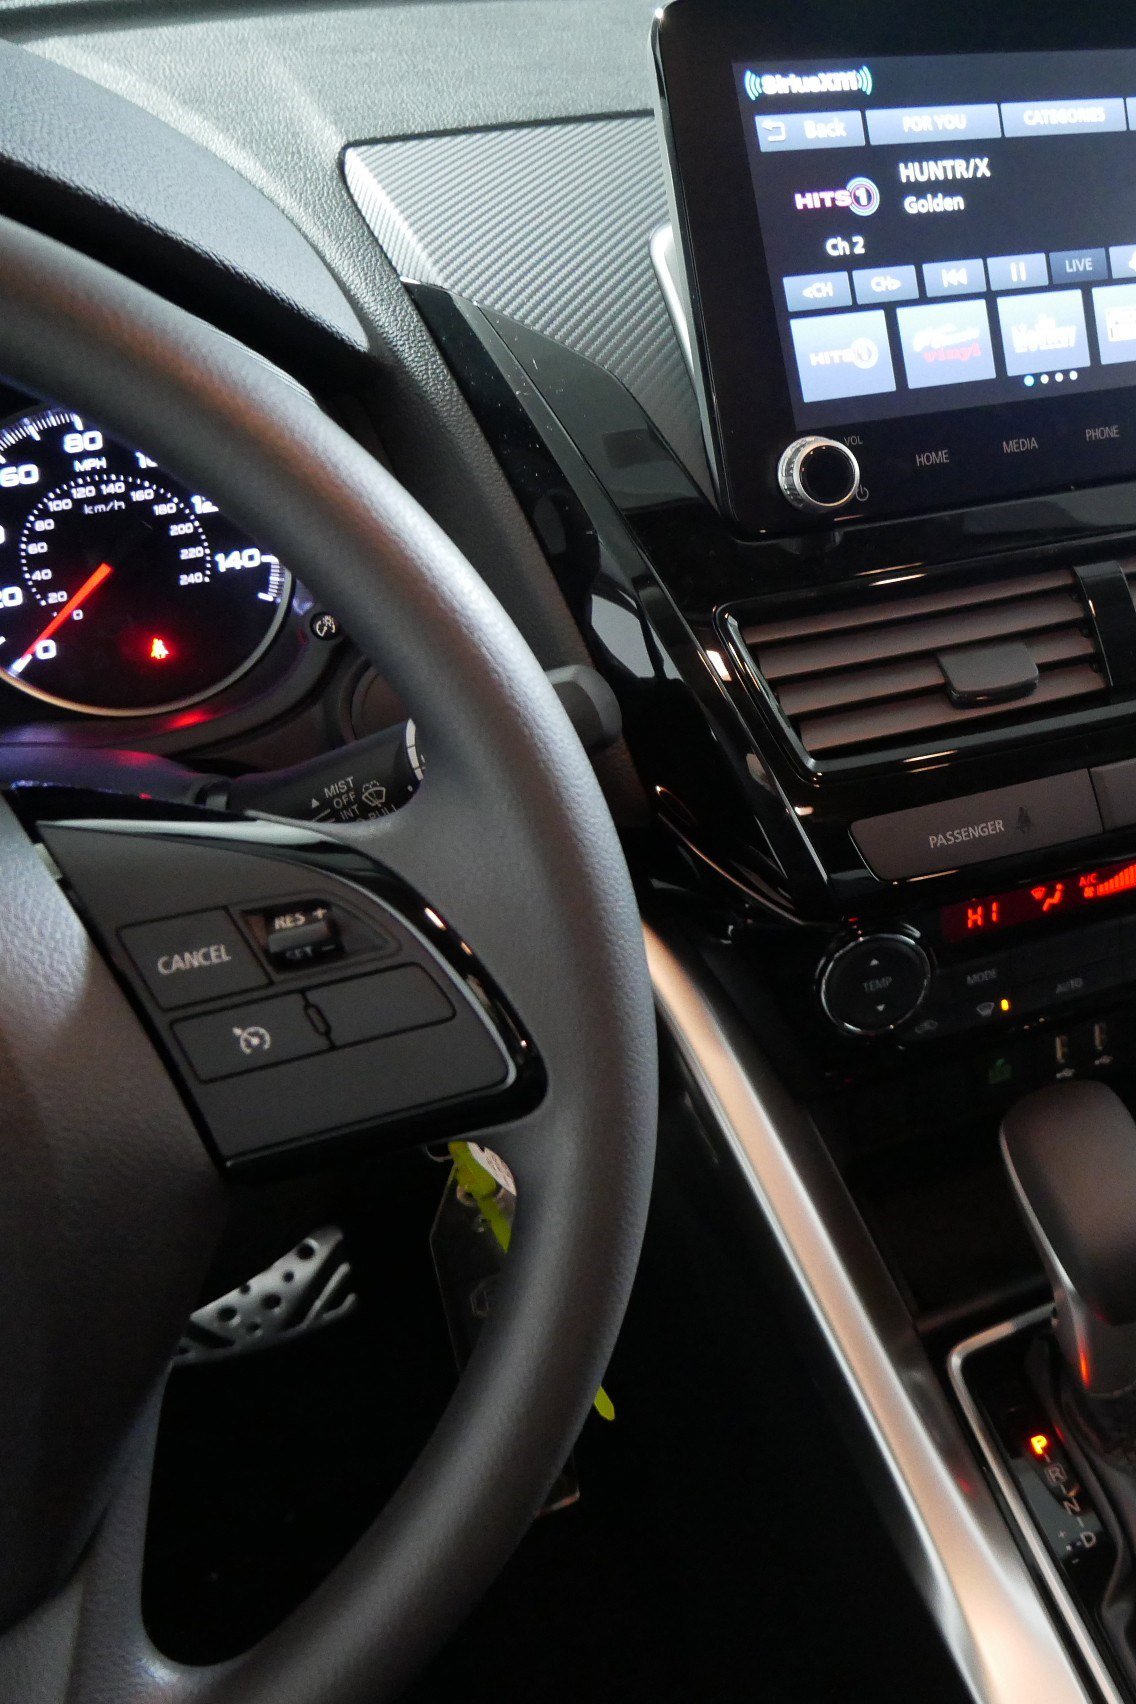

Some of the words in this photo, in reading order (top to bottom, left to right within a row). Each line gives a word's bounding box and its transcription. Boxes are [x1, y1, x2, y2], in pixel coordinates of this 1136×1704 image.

[903, 115, 934, 133] FOR
[934, 113, 967, 131] YOU
[1023, 106, 1106, 126] CATEGORIES
[803, 117, 847, 140] Back
[898, 157, 991, 184] HUNTR/X
[904, 192, 965, 215] Golden
[825, 236, 850, 256] Ch
[851, 235, 866, 255] 2
[1065, 257, 1093, 273] LIVE
[63, 430, 104, 454] 80
[843, 435, 864, 447] VOL
[1085, 425, 1120, 442] PHONE
[1002, 437, 1039, 454] MEDIA
[73, 456, 107, 473] MPH
[915, 449, 950, 467] HOME
[0, 463, 39, 488] 60
[71, 485, 96, 499] 120
[100, 481, 126, 495] 140
[48, 498, 73, 512] 100
[83, 500, 126, 515] km/h
[169, 522, 194, 537] 200
[180, 546, 204, 560] 220
[215, 548, 261, 572] 140
[31, 568, 52, 581] 40
[179, 571, 203, 586] 240
[47, 590, 68, 604] 20
[72, 608, 84, 621] 0
[35, 638, 57, 660] 0
[324, 775, 355, 799] MIST
[333, 790, 357, 809] OFF
[340, 803, 360, 821] INT
[928, 818, 1005, 850] PASSENGER
[1078, 872, 1098, 887] A/C
[157, 943, 232, 976] CANCEL
[1030, 1434, 1048, 1455] P
[1062, 1497, 1081, 1516] N
[1080, 1530, 1097, 1548] D
